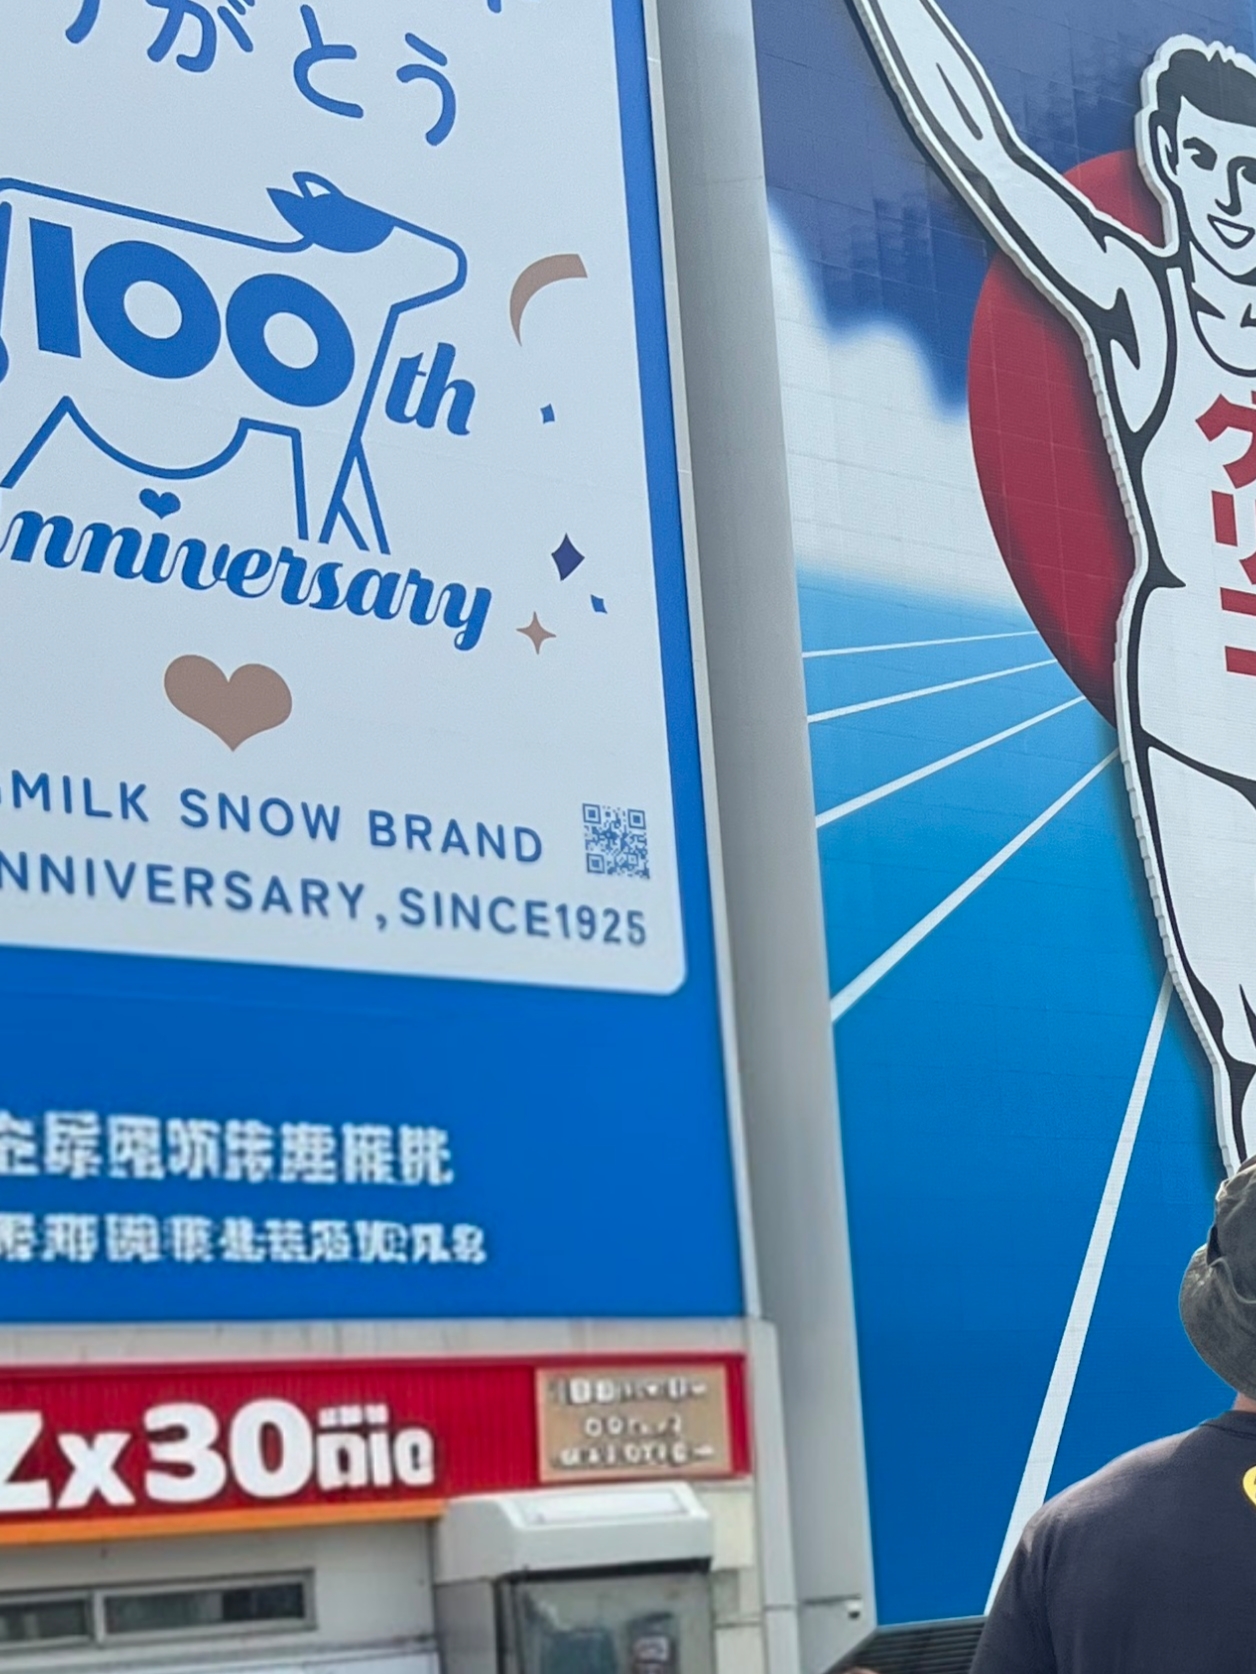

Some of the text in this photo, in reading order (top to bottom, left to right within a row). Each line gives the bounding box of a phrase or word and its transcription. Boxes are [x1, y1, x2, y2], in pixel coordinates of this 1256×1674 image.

[0, 769, 543, 863] MILK SNOW BRAND
